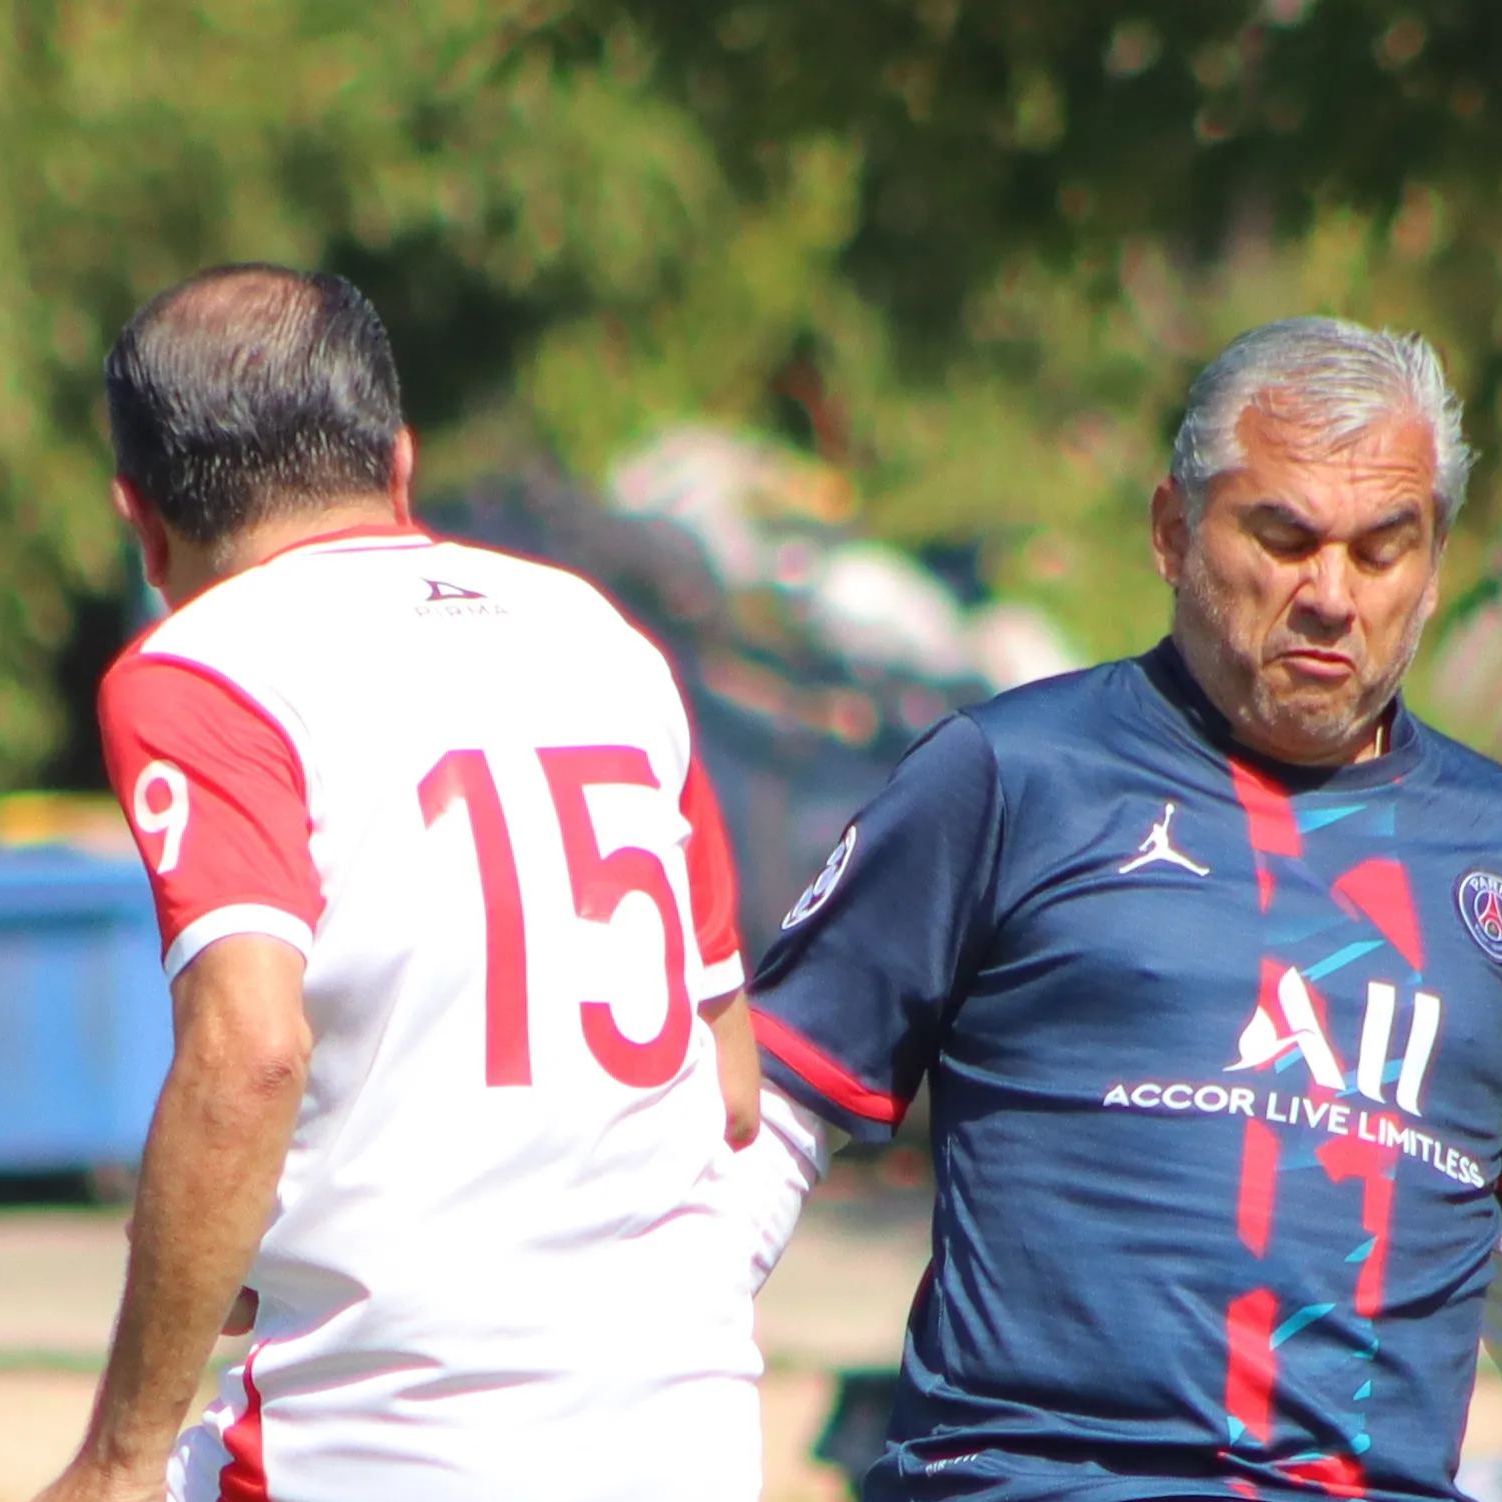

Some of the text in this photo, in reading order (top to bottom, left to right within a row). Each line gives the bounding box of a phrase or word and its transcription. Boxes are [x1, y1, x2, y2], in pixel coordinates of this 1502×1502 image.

[133, 760, 191, 876] 9
[417, 744, 694, 1089] 15
[1103, 1083, 1487, 1189] ACCOR LIVE LIMITLESS
